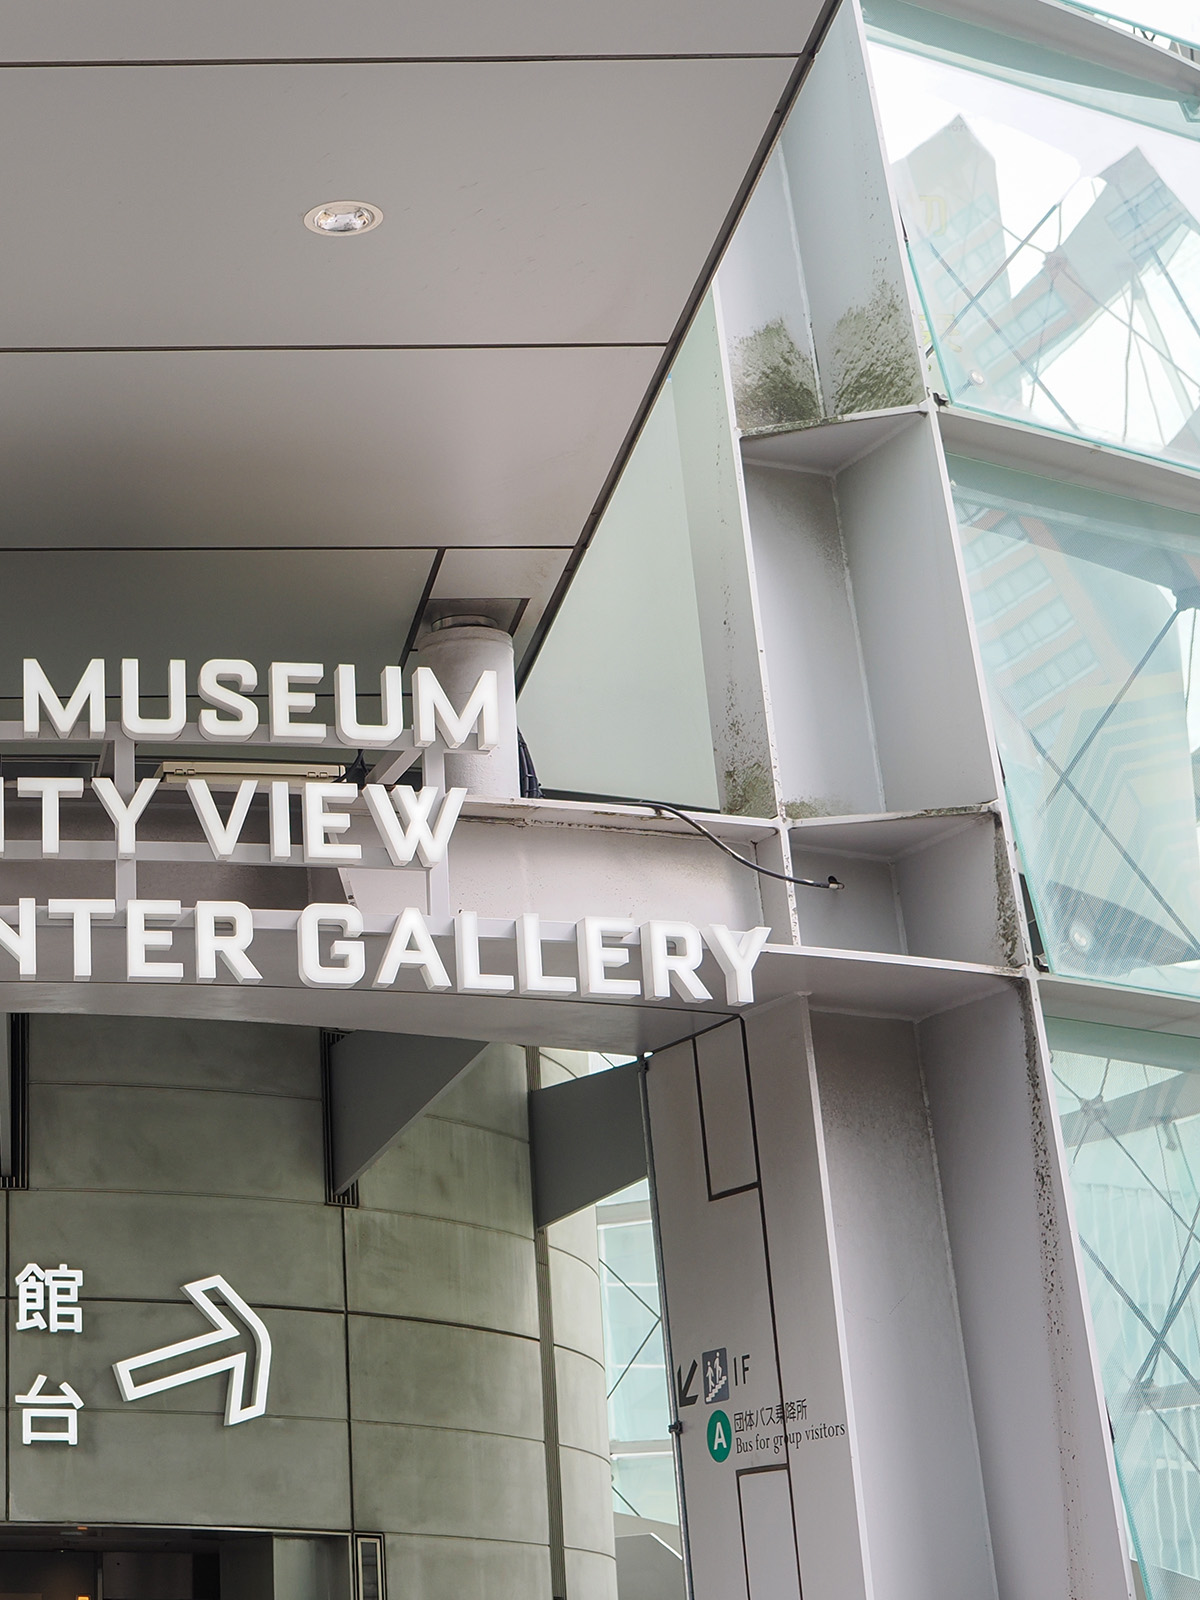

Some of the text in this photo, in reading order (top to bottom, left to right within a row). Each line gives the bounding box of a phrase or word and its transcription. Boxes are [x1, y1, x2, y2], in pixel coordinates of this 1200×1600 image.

[23, 658, 498, 751] MUSEUM
[185, 778, 467, 868] VIEW
[297, 902, 772, 1007] GALLERY
[713, 1421, 727, 1450] A
[736, 1437, 753, 1454] Bus
[756, 1433, 770, 1450] for
[805, 1423, 845, 1441] visitors
